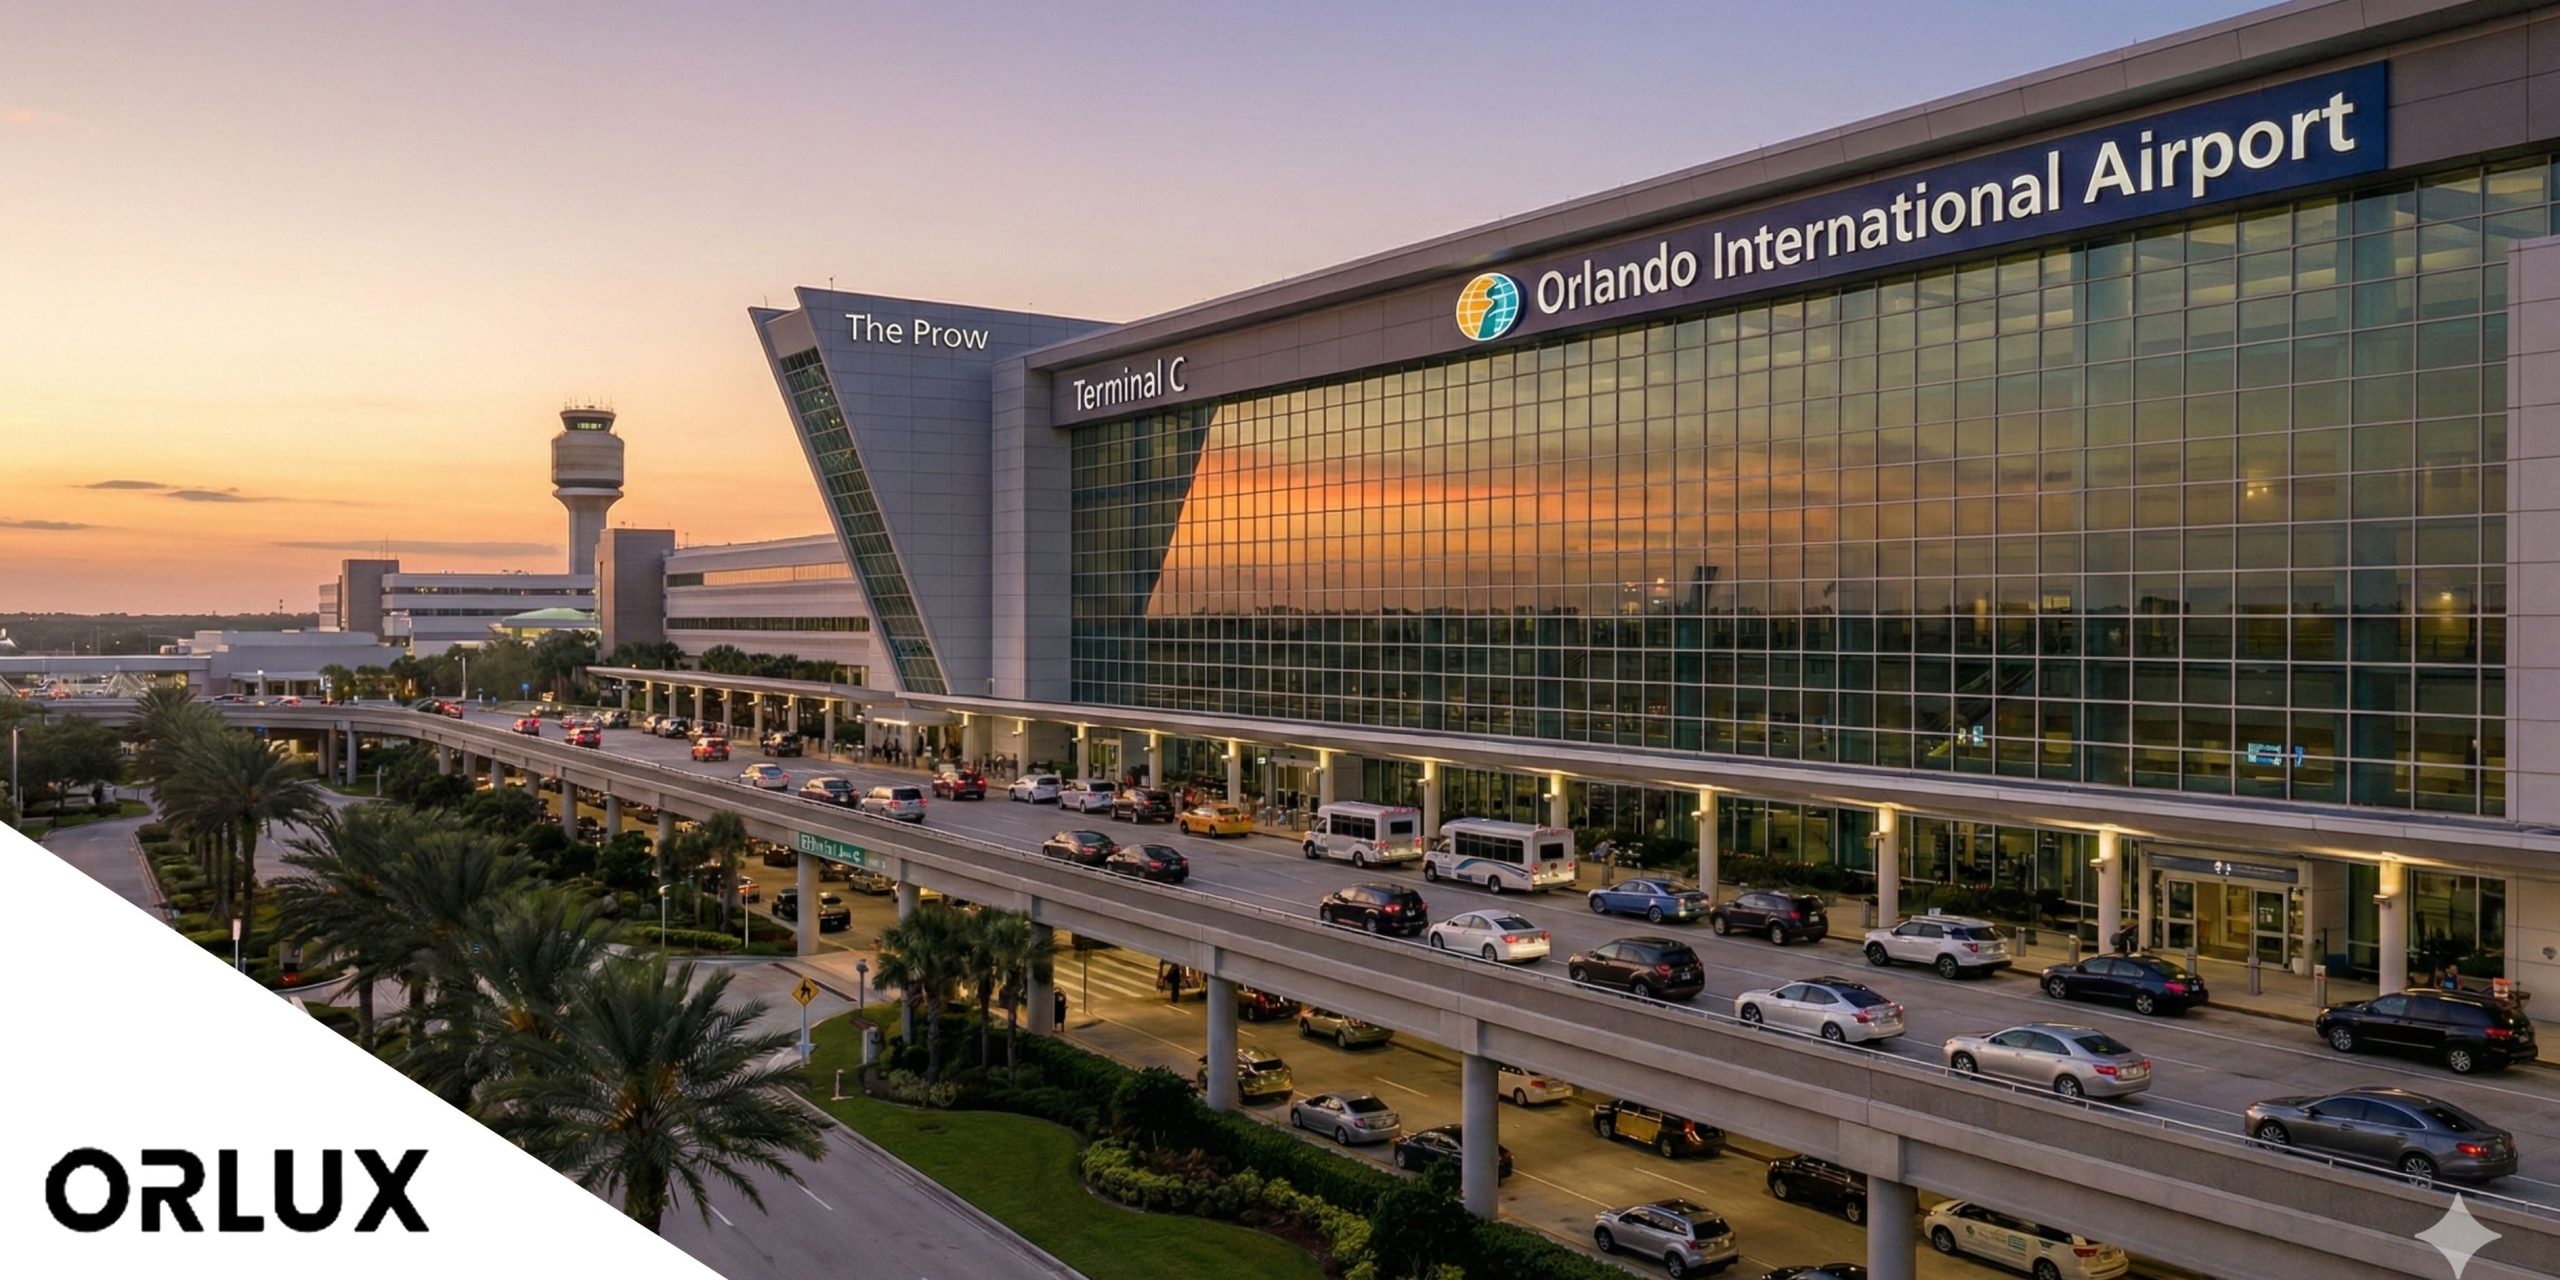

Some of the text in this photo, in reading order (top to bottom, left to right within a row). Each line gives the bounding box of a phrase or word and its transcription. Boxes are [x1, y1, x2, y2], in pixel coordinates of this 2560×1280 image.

[1537, 91, 2356, 314] Orlando International Airport
[845, 313, 989, 349] The Prow
[1073, 356, 1185, 411] Terminal C
